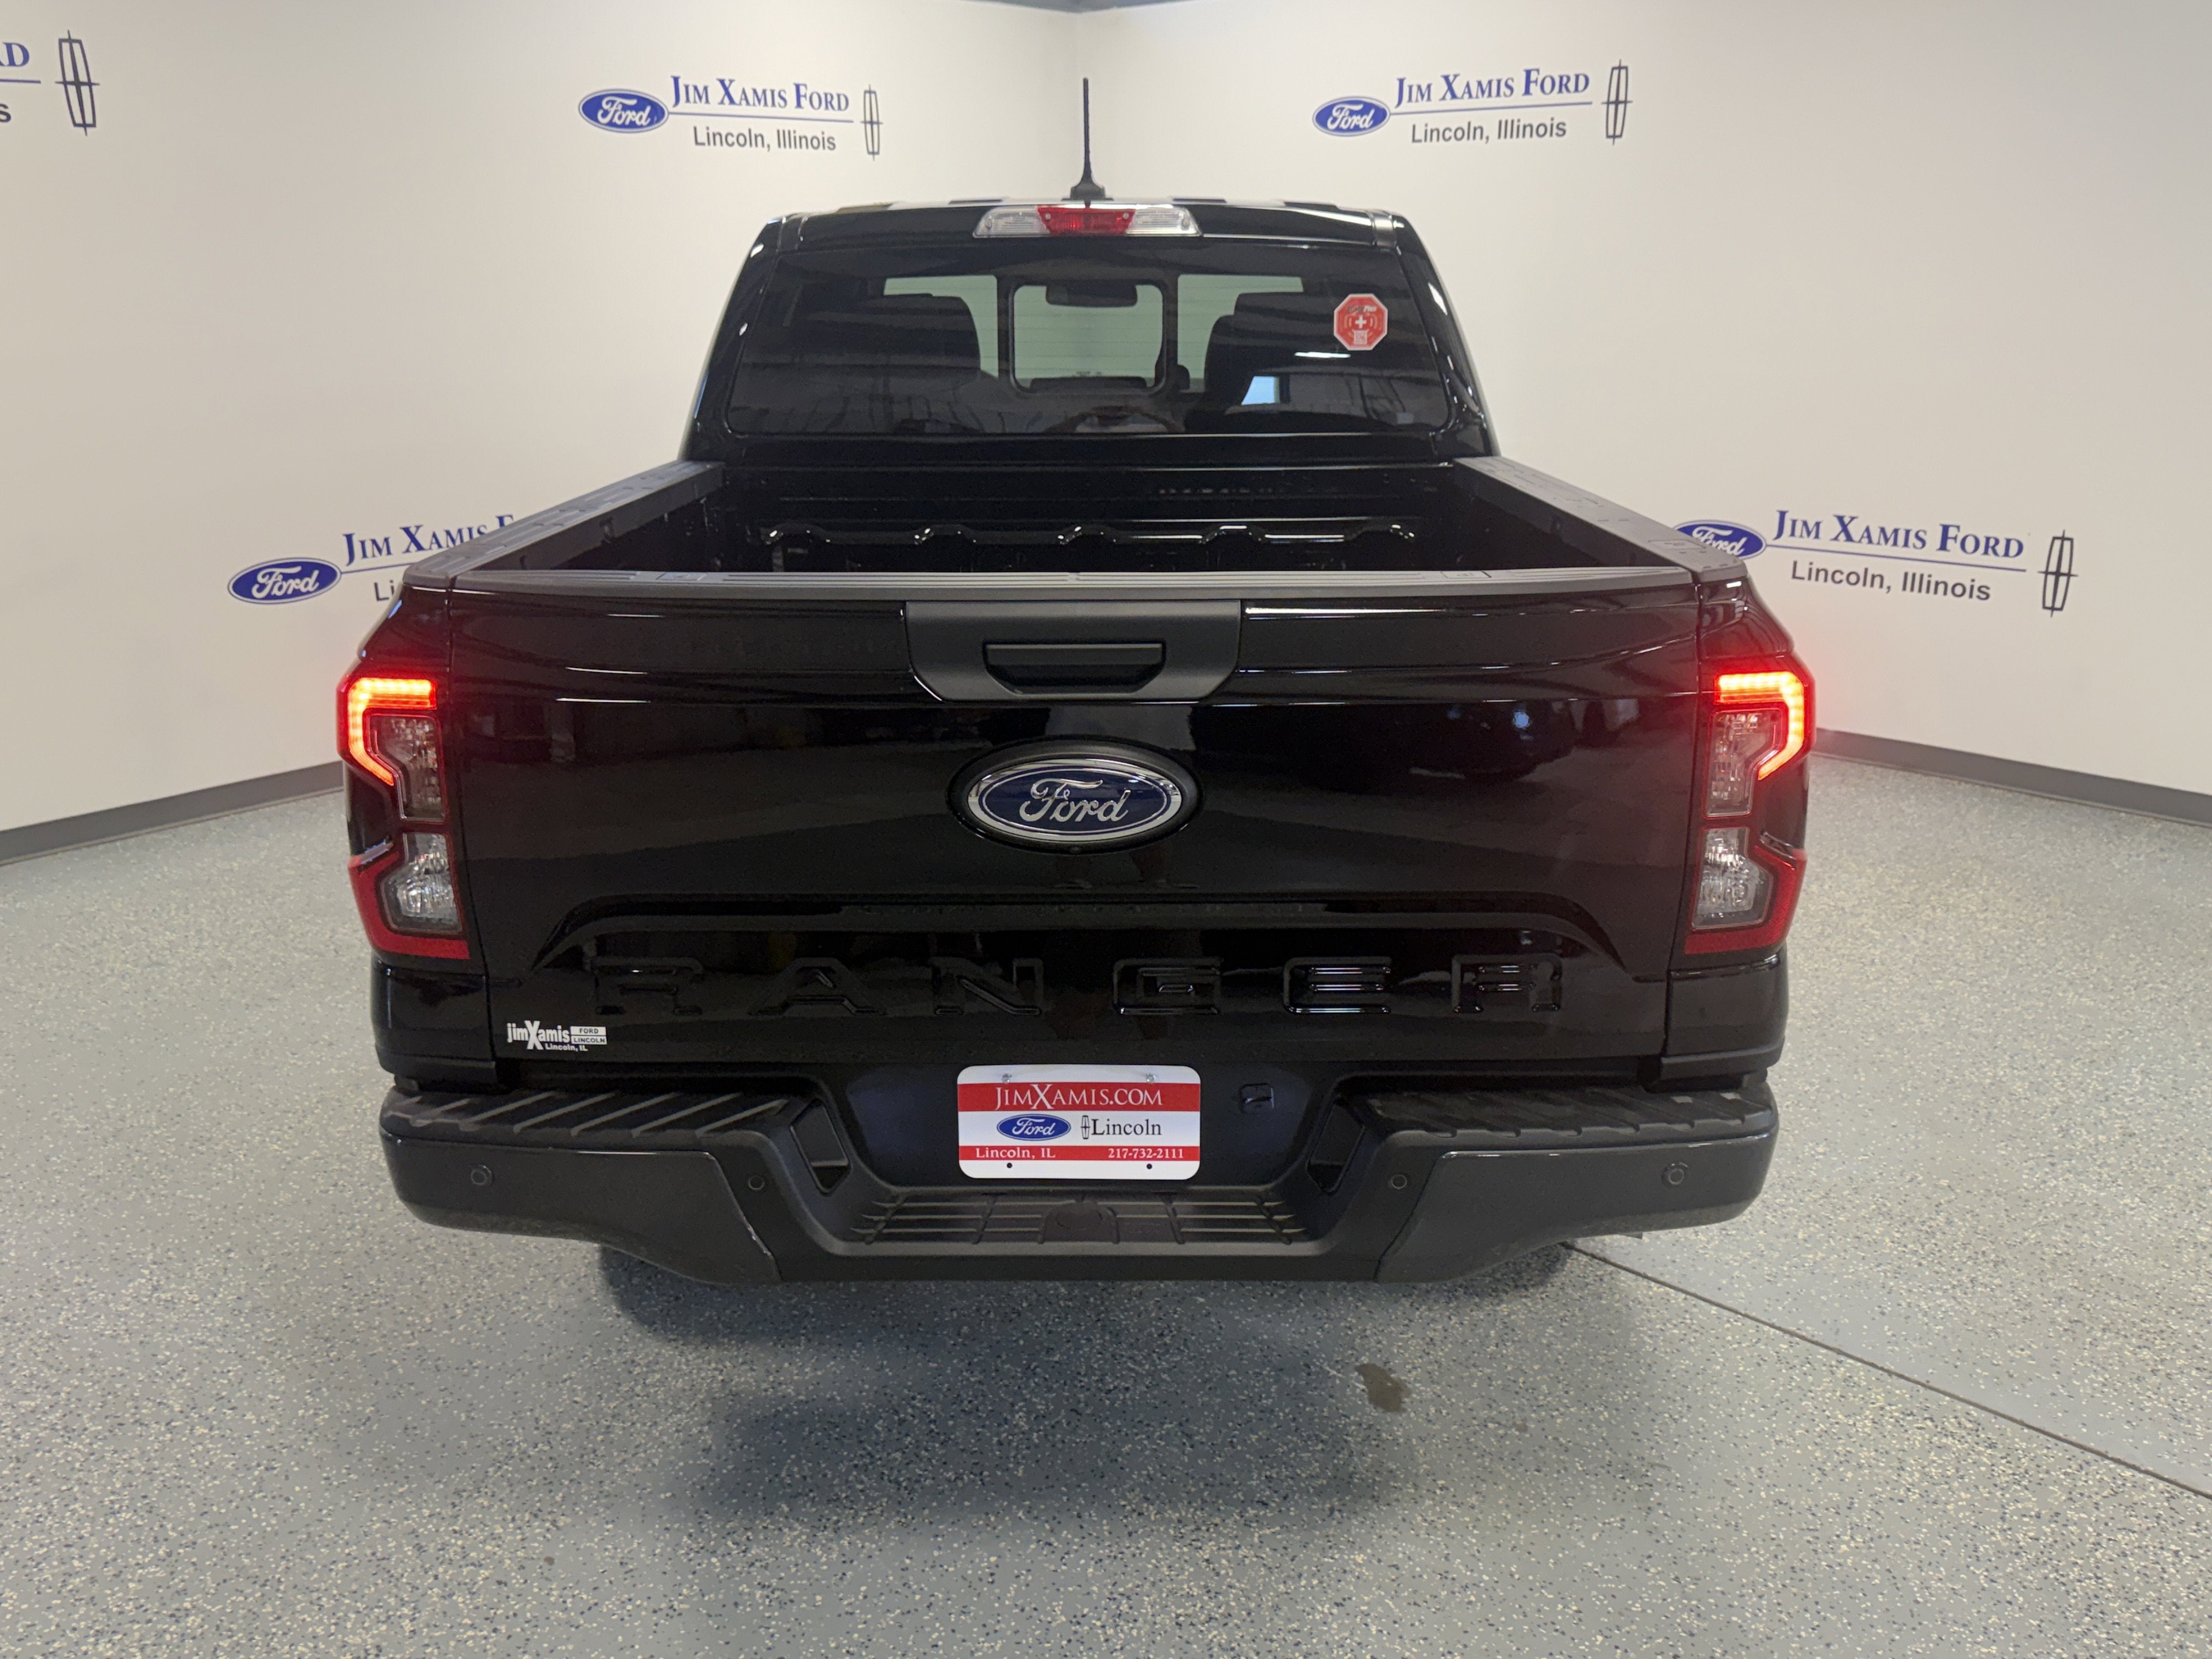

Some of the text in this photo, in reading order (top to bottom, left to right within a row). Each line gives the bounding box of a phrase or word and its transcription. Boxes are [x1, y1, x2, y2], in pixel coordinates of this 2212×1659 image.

[670, 75, 850, 111] JIM XAMIS FORD
[1395, 68, 1590, 109] JIM XAMIS FORD
[597, 96, 651, 126] Ford
[1327, 104, 1374, 129] Ford
[693, 126, 837, 152] Lincoln, Illinois
[1411, 118, 1567, 144] Lincoln, Illinois
[1773, 510, 2025, 559] JIM XAMIS FORD
[342, 533, 392, 566] JIM
[251, 566, 320, 599] Ford
[1791, 560, 1991, 601] Lincoln, Illinois
[1019, 778, 1131, 822] Ford
[590, 955, 1564, 1016] RANGER
[545, 1043, 578, 1052] Lincoln,
[994, 1084, 1164, 1110] JIMXAMIS.COM
[1012, 1118, 1056, 1136] Ford
[1091, 1118, 1163, 1136] Lincoln
[975, 1147, 1056, 1159] Lincoln, IL
[1108, 1148, 1184, 1159] 217-732-2111
